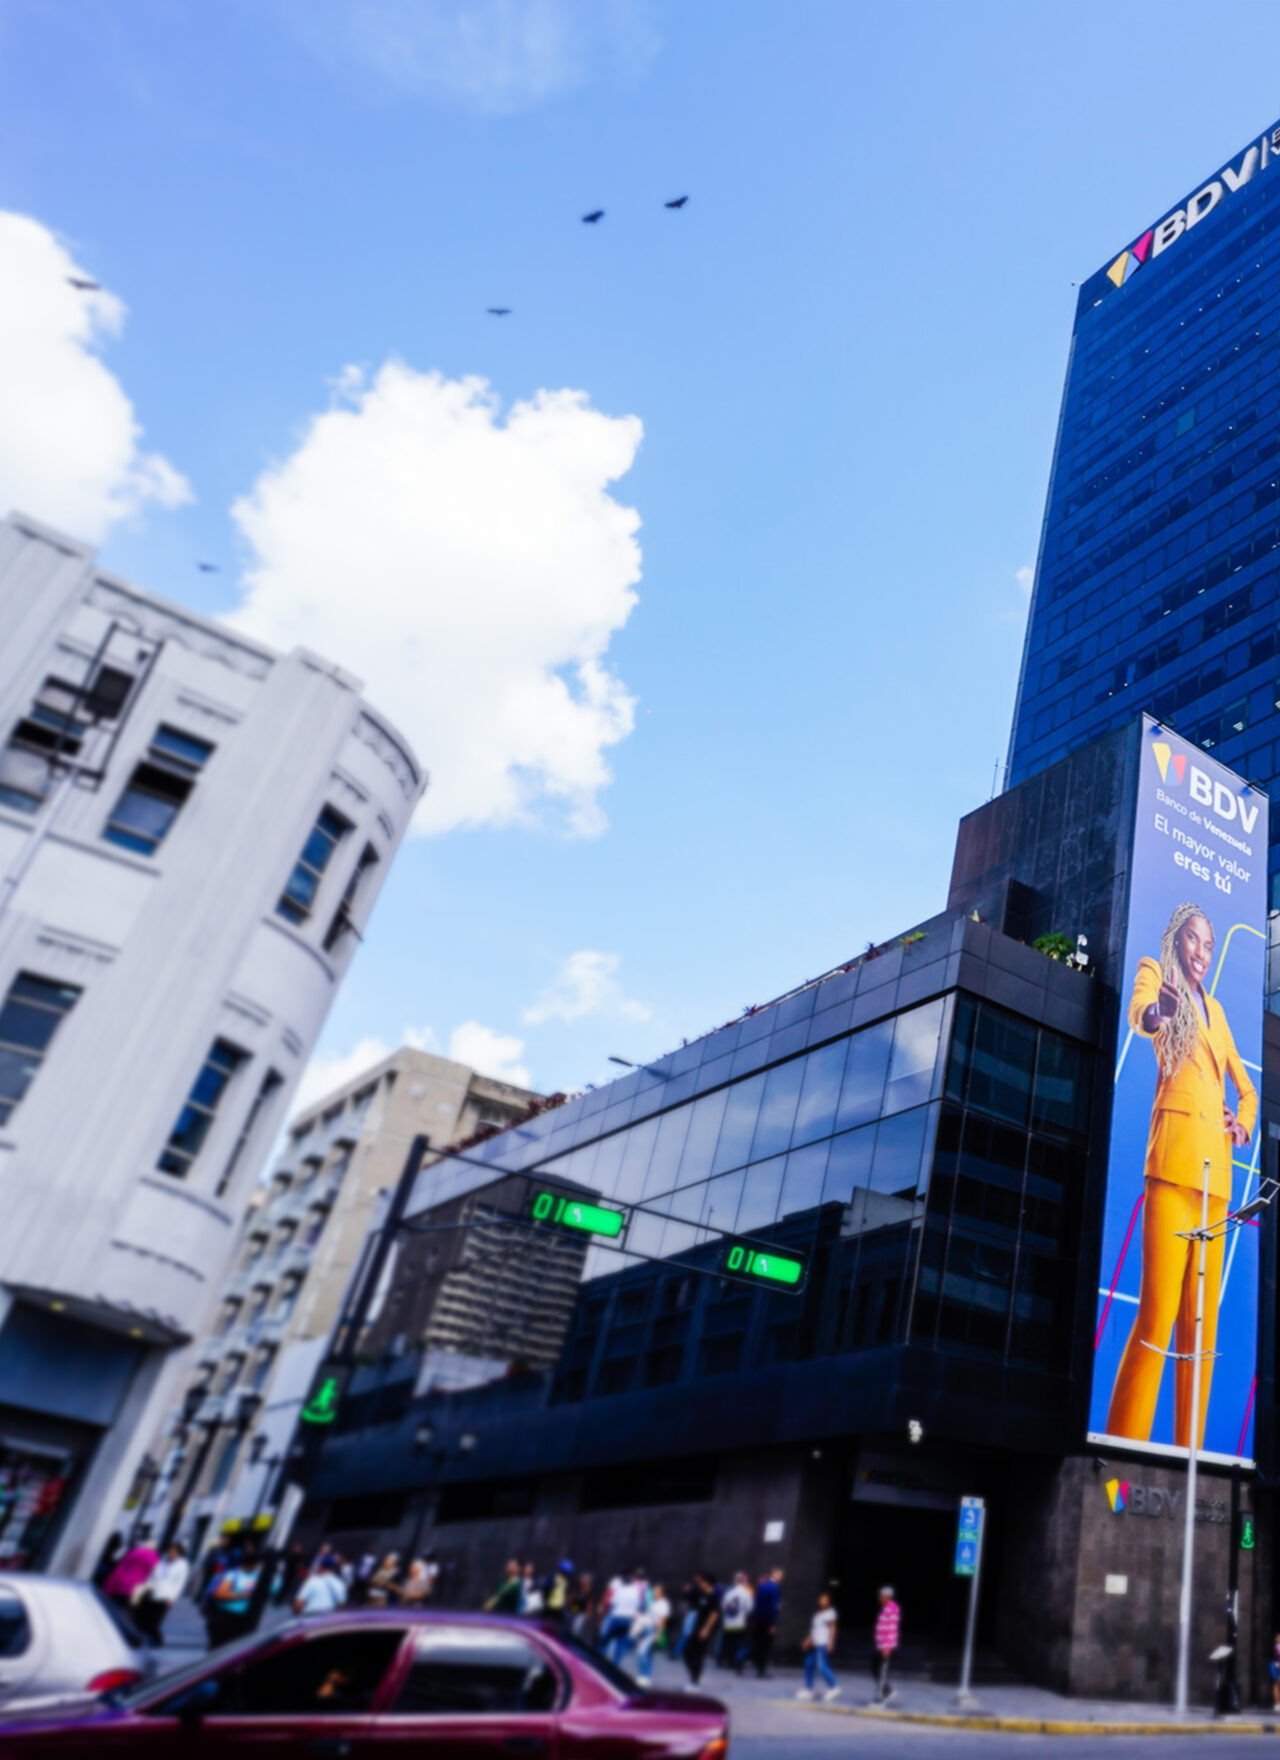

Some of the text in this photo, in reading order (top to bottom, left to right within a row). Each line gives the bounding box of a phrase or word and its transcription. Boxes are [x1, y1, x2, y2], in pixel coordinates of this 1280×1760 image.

[1152, 146, 1259, 258] BDV
[1156, 788, 1252, 857] Banco de Venezuela
[1190, 765, 1259, 835] BDV
[1154, 813, 1252, 883] El mayor valor
[1173, 851, 1232, 895] eres tú
[1128, 1484, 1181, 1519] BDV
